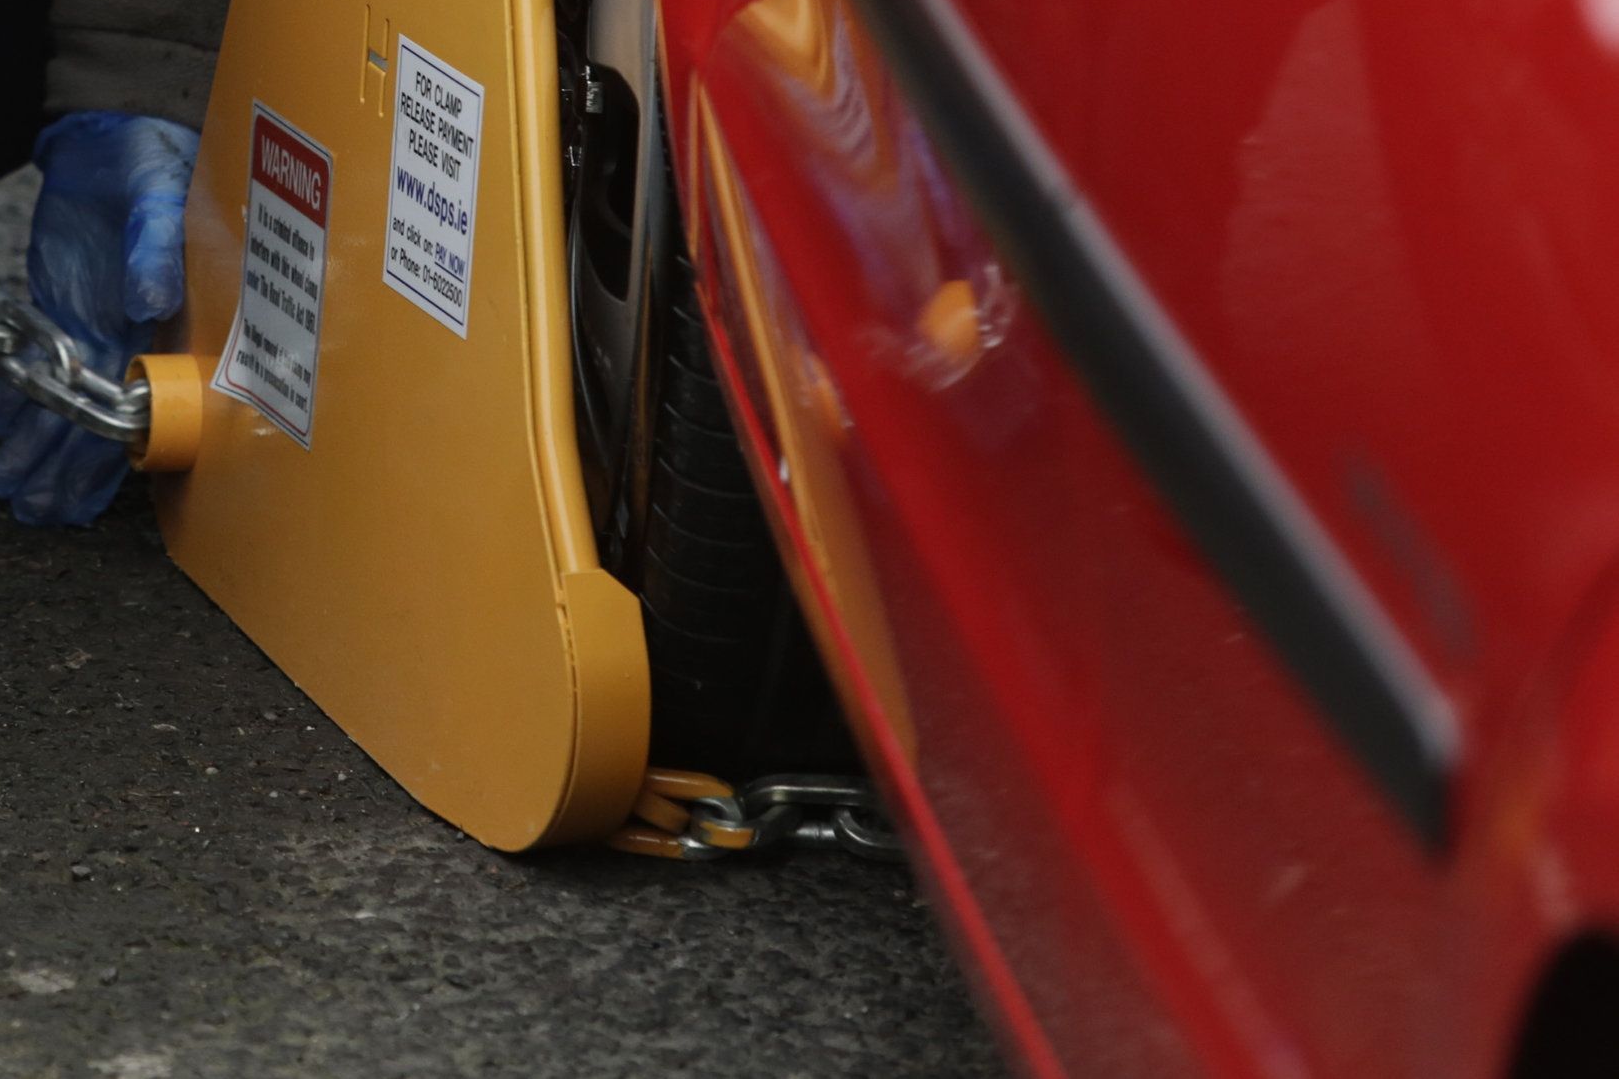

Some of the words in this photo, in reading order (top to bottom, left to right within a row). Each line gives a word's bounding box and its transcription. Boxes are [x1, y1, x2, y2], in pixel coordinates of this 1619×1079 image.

[400, 92, 435, 134] RELEASE
[438, 117, 474, 159] PAYMENT
[416, 71, 431, 101] FOR
[434, 85, 463, 119] CLAMP
[261, 135, 321, 211] WARNING
[409, 128, 438, 168] PLEASE
[441, 150, 461, 182] VISIT
[397, 166, 468, 235] www.dsps.ie
[391, 246, 398, 260] or
[399, 248, 421, 279] Phone:
[422, 265, 462, 308] 01-6022500
[393, 217, 405, 236] and
[406, 223, 421, 248] click
[424, 237, 433, 256] on:
[435, 242, 447, 265] PAY
[449, 251, 466, 275] NOW
